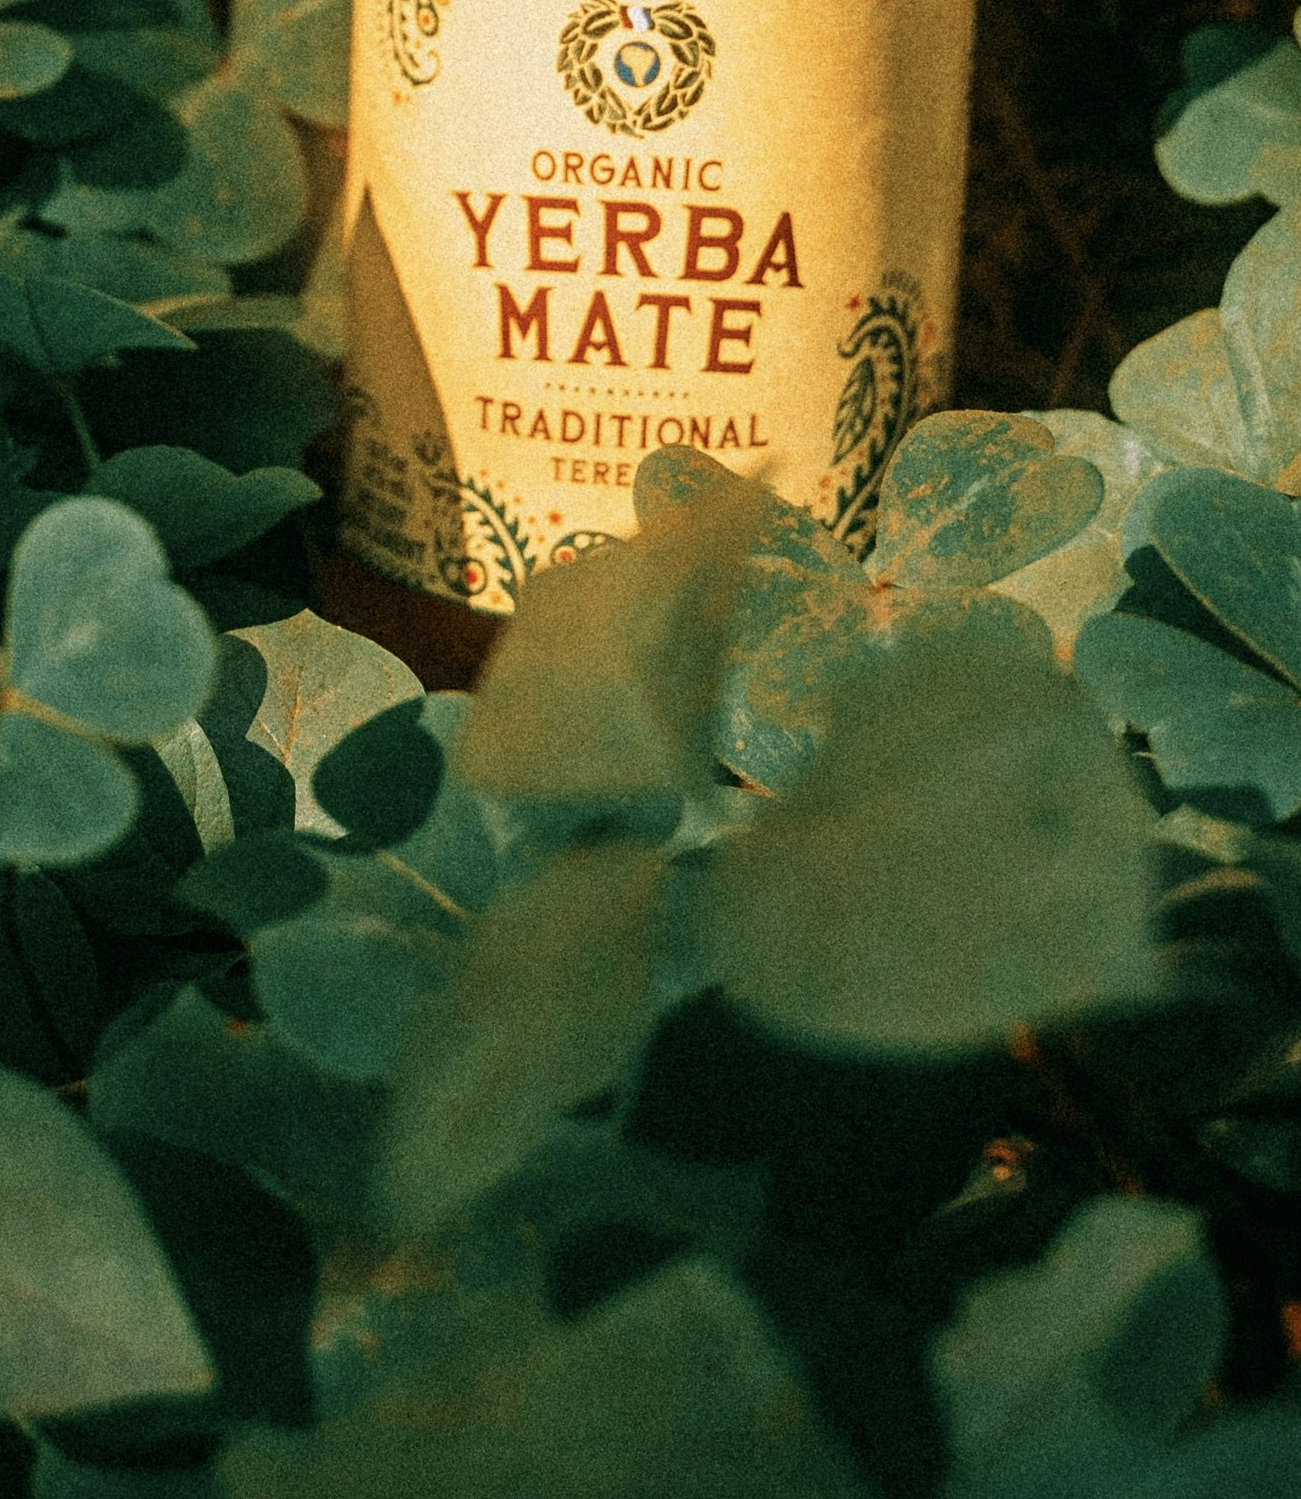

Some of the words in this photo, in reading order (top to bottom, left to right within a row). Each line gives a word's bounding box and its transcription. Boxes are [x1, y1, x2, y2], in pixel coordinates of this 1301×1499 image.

[532, 150, 723, 191] ORGANIC
[453, 191, 804, 288] YERBA
[495, 283, 763, 374] MATE
[475, 395, 770, 449] TRADITIONAL
[551, 457, 632, 487] TERE
